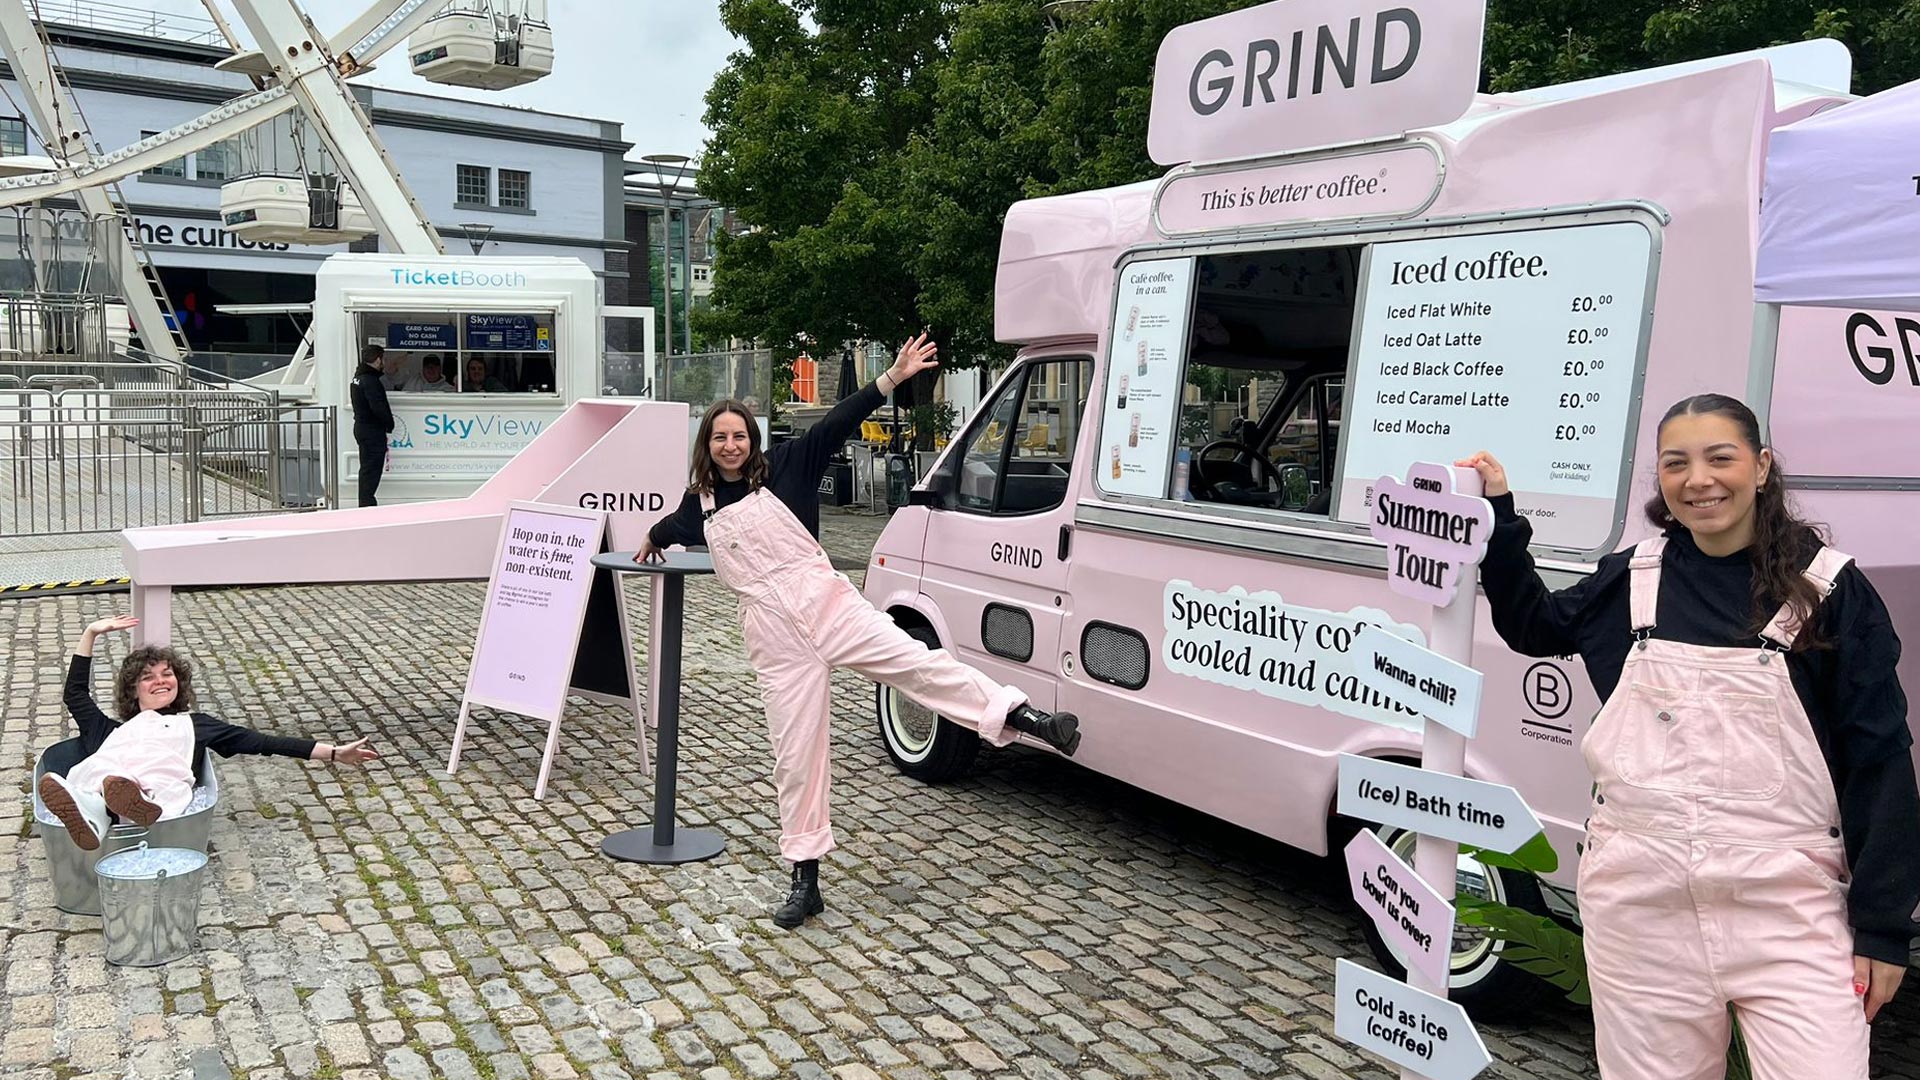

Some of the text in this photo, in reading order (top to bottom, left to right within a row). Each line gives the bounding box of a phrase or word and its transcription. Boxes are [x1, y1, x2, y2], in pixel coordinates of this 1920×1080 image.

[1188, 7, 1422, 116] GRIND
[1200, 188, 1237, 211] This
[1239, 186, 1255, 208] is
[1258, 184, 1313, 206] better
[122, 217, 173, 244] the
[390, 268, 526, 287] TicketBooth
[1390, 250, 1548, 286] Iced coffee.
[1135, 285, 1145, 295] in
[1145, 286, 1151, 295] a
[470, 315, 513, 326] SkyView
[1386, 304, 1415, 320] Iced
[1419, 303, 1446, 318] Flat
[1449, 301, 1492, 317] White
[1383, 333, 1412, 348] Iced
[1416, 332, 1441, 347] Oat
[1444, 332, 1482, 347] Latte
[1379, 362, 1409, 376] Iced
[1412, 361, 1450, 376] Black
[1453, 361, 1504, 376] Coffee
[1376, 390, 1405, 405] Iced
[1408, 390, 1467, 406] Caramel
[1470, 391, 1510, 407] Latte
[424, 413, 542, 439] SkyView
[1372, 418, 1402, 433] Iced
[1405, 419, 1451, 436] Mocha
[425, 441, 440, 449] THE
[443, 441, 478, 449] WORLD
[479, 441, 491, 449] AT
[493, 441, 518, 449] YOUR
[1551, 461, 1592, 471] CASH ONLY.
[1412, 476, 1443, 494] GRIND
[578, 491, 665, 512] GRIND
[1376, 493, 1479, 546] Summer
[1535, 508, 1557, 518] door.
[511, 527, 533, 544] Hop
[534, 532, 549, 544] on
[566, 534, 585, 549] the
[508, 545, 539, 559] water
[539, 546, 550, 560] is
[990, 541, 1043, 569] GRIND
[505, 561, 573, 581] non-existent.
[1394, 543, 1450, 590] Tour
[1171, 591, 1309, 654] Speciality
[1170, 636, 1251, 677] cooled
[1259, 656, 1317, 692] and
[508, 672, 527, 682] GRIND
[1373, 651, 1458, 707] Wanna chill?
[1536, 671, 1560, 708] B
[1521, 726, 1573, 746] Corporation
[1357, 778, 1506, 829] (Ice) Bath time
[1376, 864, 1420, 917] Can you
[1362, 871, 1433, 953] bowl us over?
[1354, 988, 1449, 1042] Cold as ice
[1366, 1015, 1435, 1062] (coffee)
